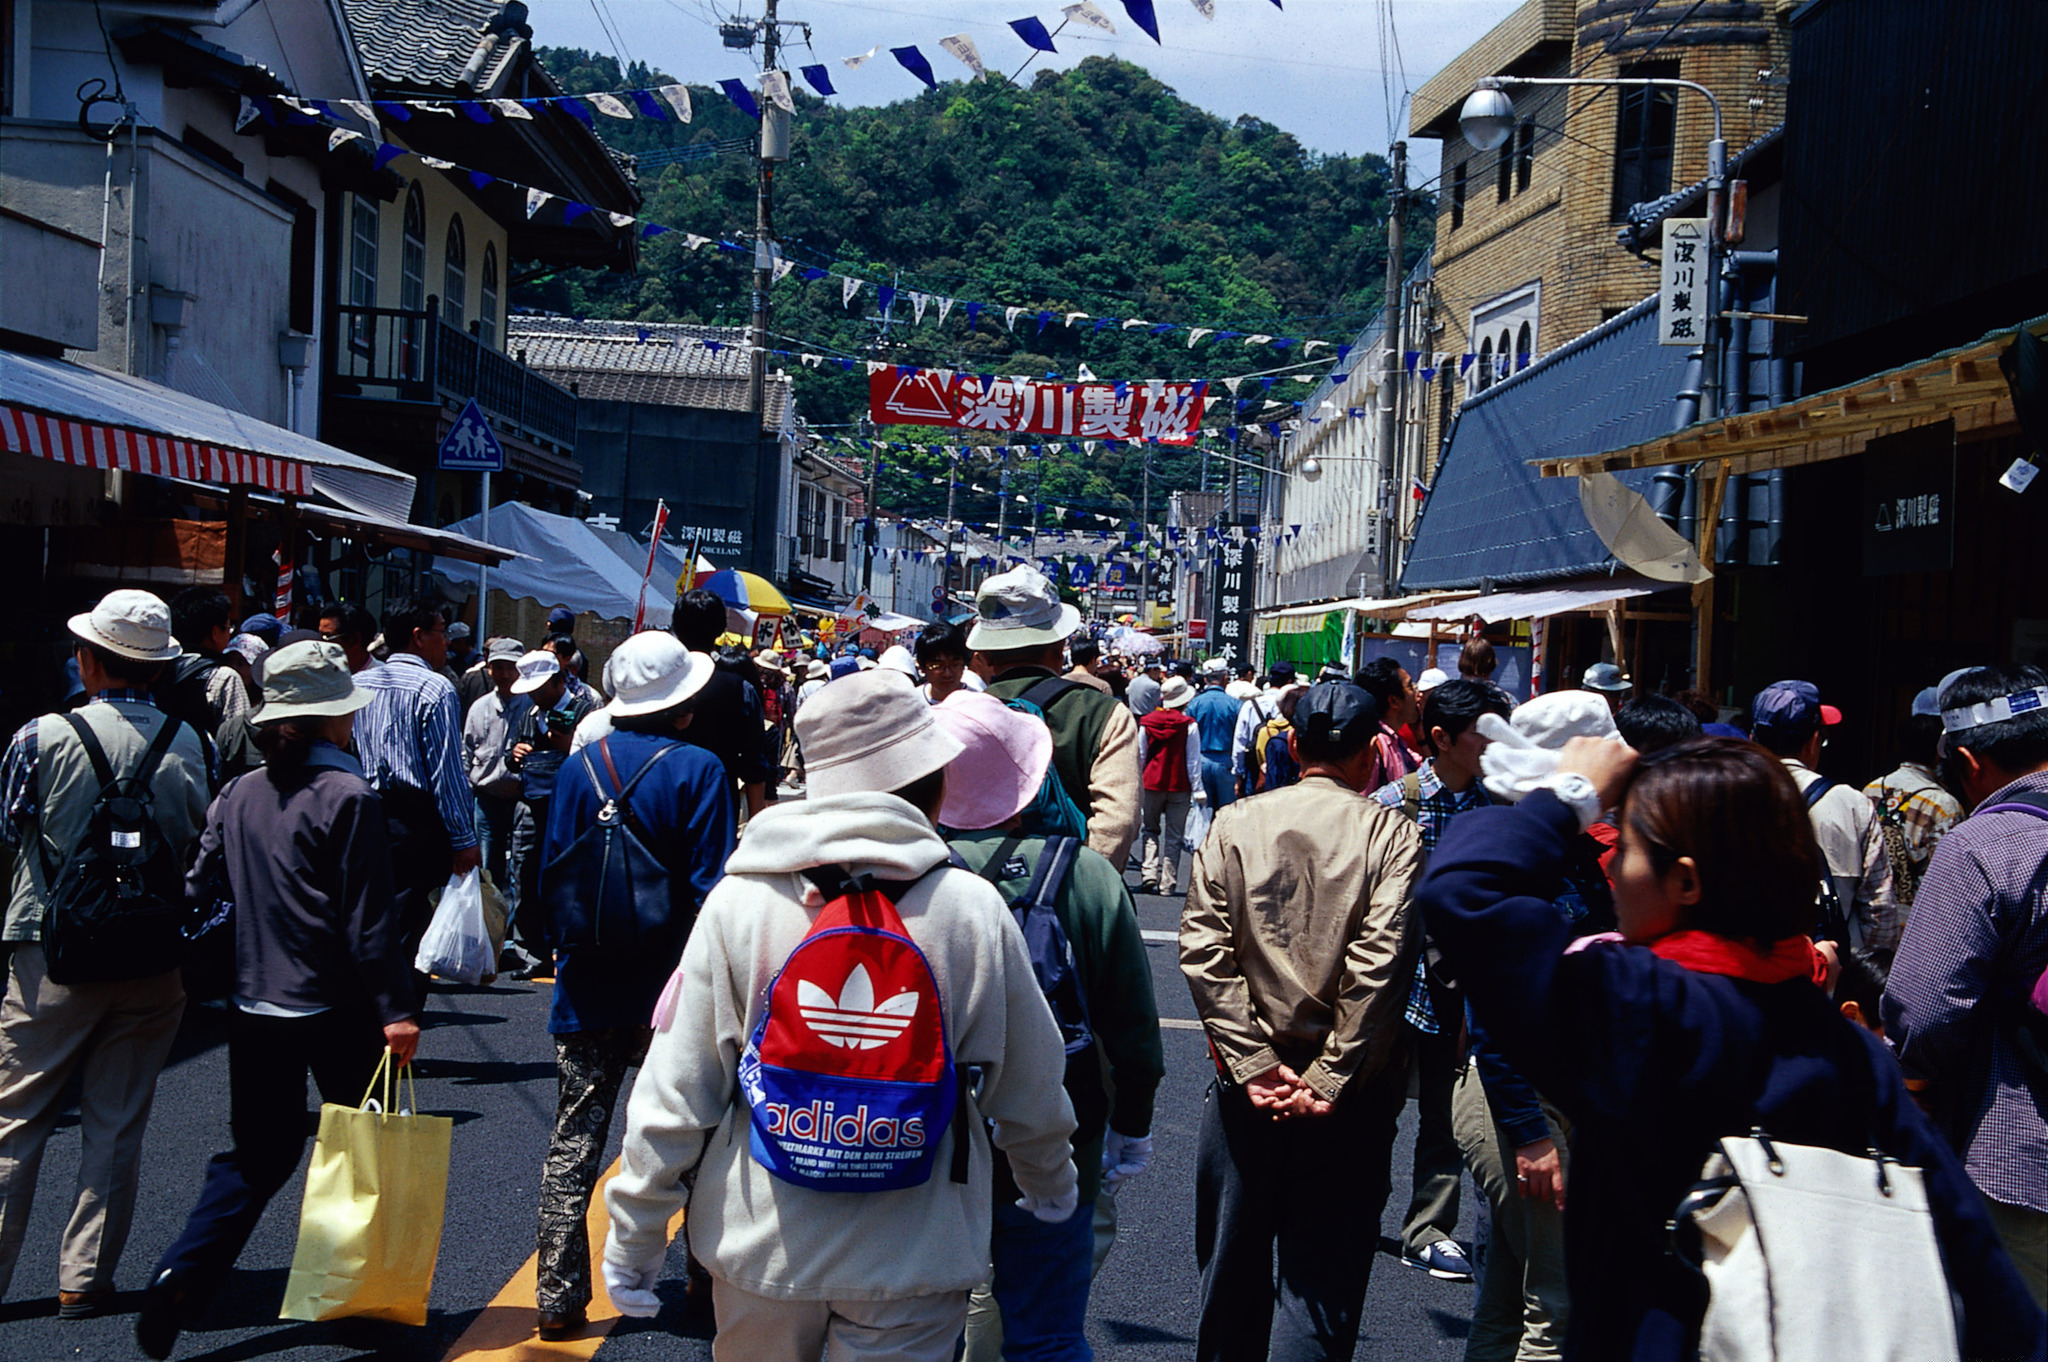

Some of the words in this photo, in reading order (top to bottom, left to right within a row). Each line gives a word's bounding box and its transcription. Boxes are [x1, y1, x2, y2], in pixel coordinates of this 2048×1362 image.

[1670, 241, 1696, 339] 深川製磁
[956, 378, 1195, 440] 深川製磁
[700, 546, 741, 555] ORCELAIN
[766, 1099, 926, 1148] adidas
[795, 1156, 817, 1167] BRAND
[818, 1160, 836, 1169] WITH
[825, 1149, 843, 1159] MIT
[843, 1150, 862, 1160] DEN
[863, 1151, 884, 1161] DREI
[885, 1149, 923, 1160] STREIFEN
